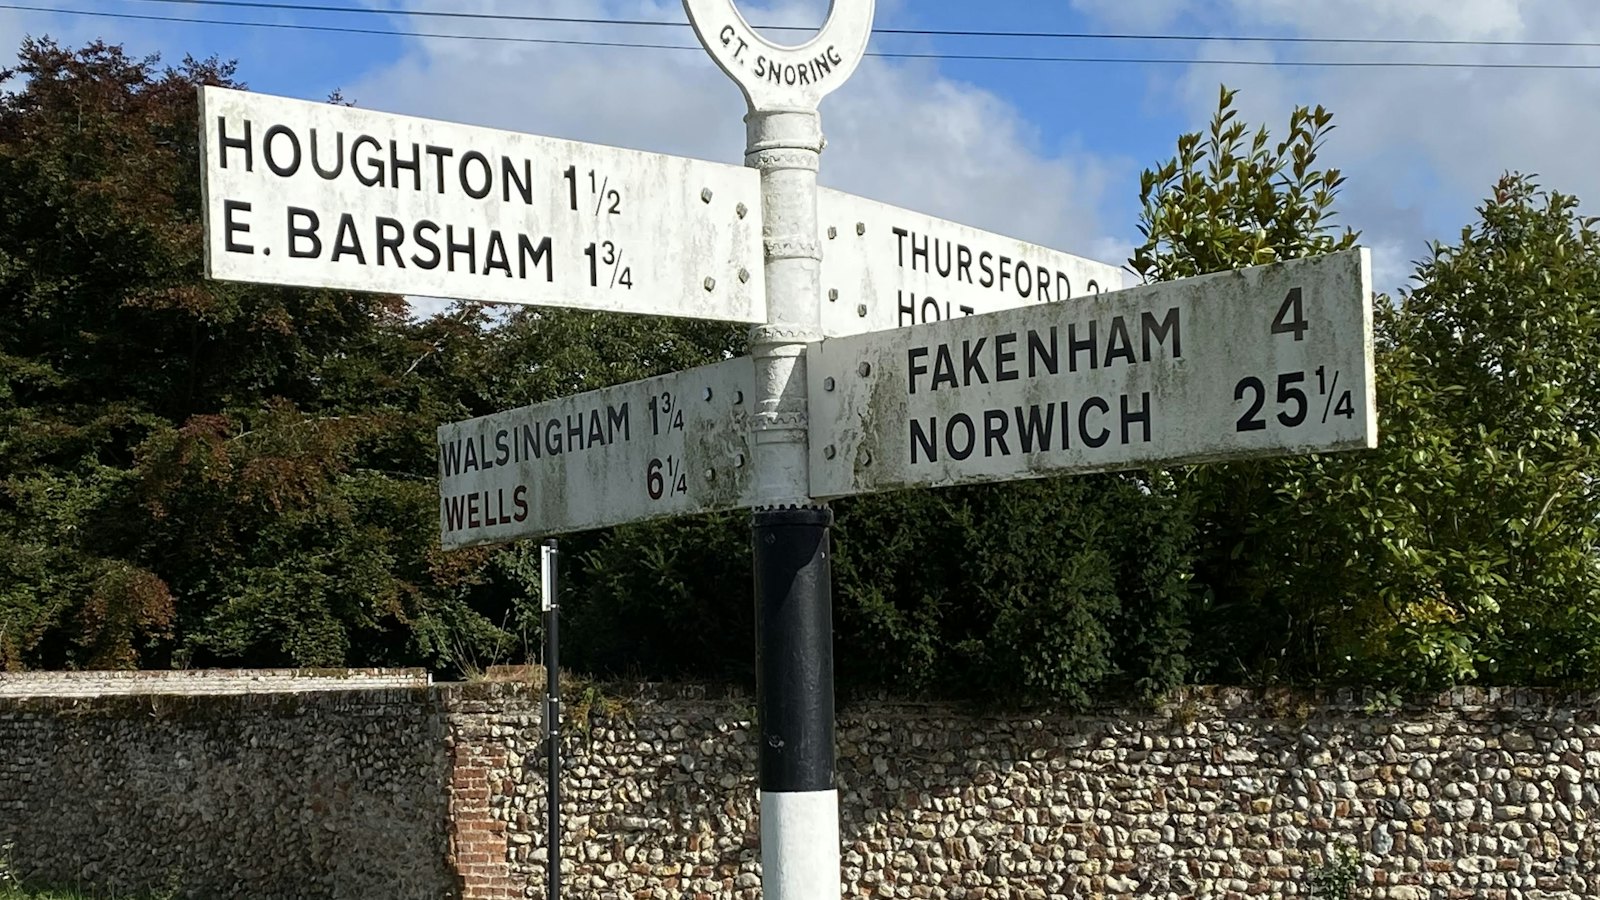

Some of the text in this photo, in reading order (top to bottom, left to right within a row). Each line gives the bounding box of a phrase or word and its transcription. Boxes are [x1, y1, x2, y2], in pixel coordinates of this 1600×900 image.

[719, 24, 842, 86] GT. SNORING
[218, 115, 533, 206] HOUGHTON
[224, 200, 271, 257] E.
[286, 205, 554, 284] BARSHAM
[892, 226, 1071, 301] THURSFORD
[897, 289, 975, 327] HO
[907, 287, 1309, 394] FAKENHAM 4
[441, 402, 631, 477] WALSINGHAM
[909, 391, 1153, 465] NORWICH
[444, 485, 529, 532] WELLS
